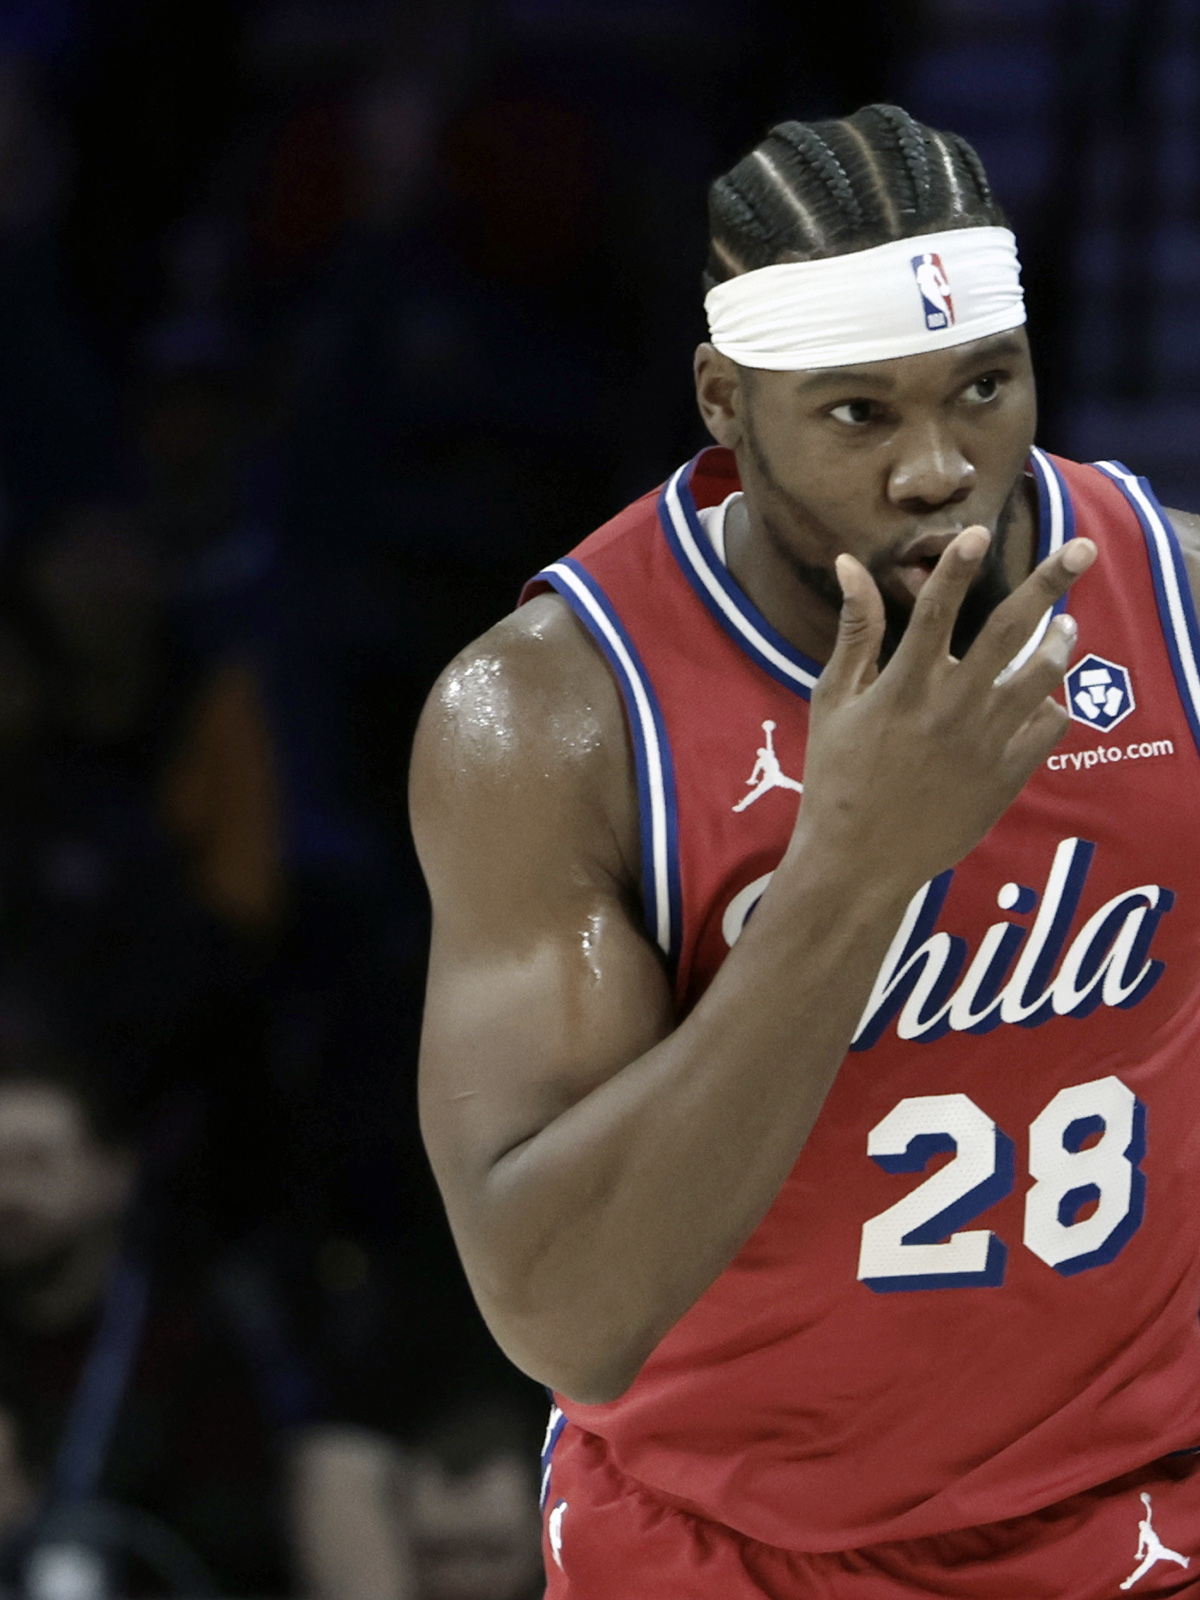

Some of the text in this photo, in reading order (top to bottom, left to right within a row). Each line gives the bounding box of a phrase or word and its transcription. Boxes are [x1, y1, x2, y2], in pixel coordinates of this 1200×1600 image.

[1046, 739, 1174, 771] crypto.com
[722, 837, 1174, 1051] hila
[857, 1075, 1148, 1293] 28
